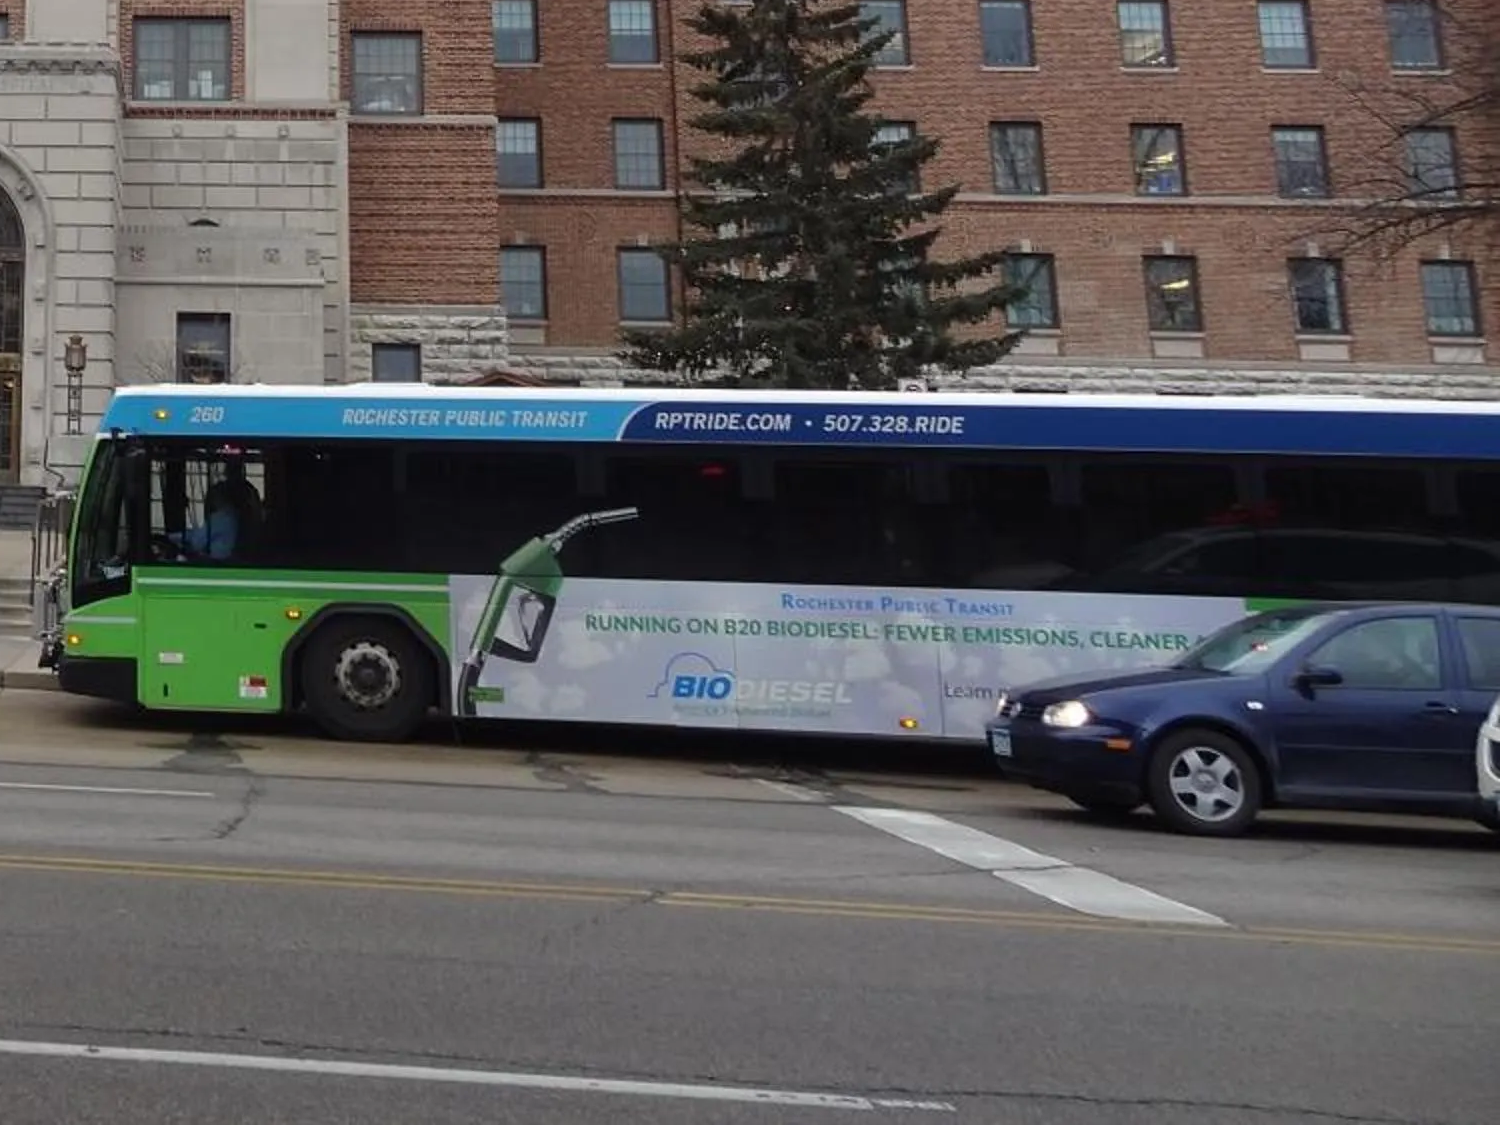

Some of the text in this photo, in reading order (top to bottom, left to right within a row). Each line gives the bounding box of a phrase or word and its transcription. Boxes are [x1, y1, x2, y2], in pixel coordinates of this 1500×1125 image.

[190, 406, 225, 424] 260
[342, 407, 588, 428] ROCHESTER PUBLIC TRANSIT
[655, 412, 965, 435] RPTRIDE.COM 507.328.RIDE
[585, 613, 682, 635] RUNNING
[687, 617, 718, 636] ON
[724, 618, 762, 637] B20
[885, 623, 957, 644] FEWER
[1090, 631, 1190, 652] CLEANER
